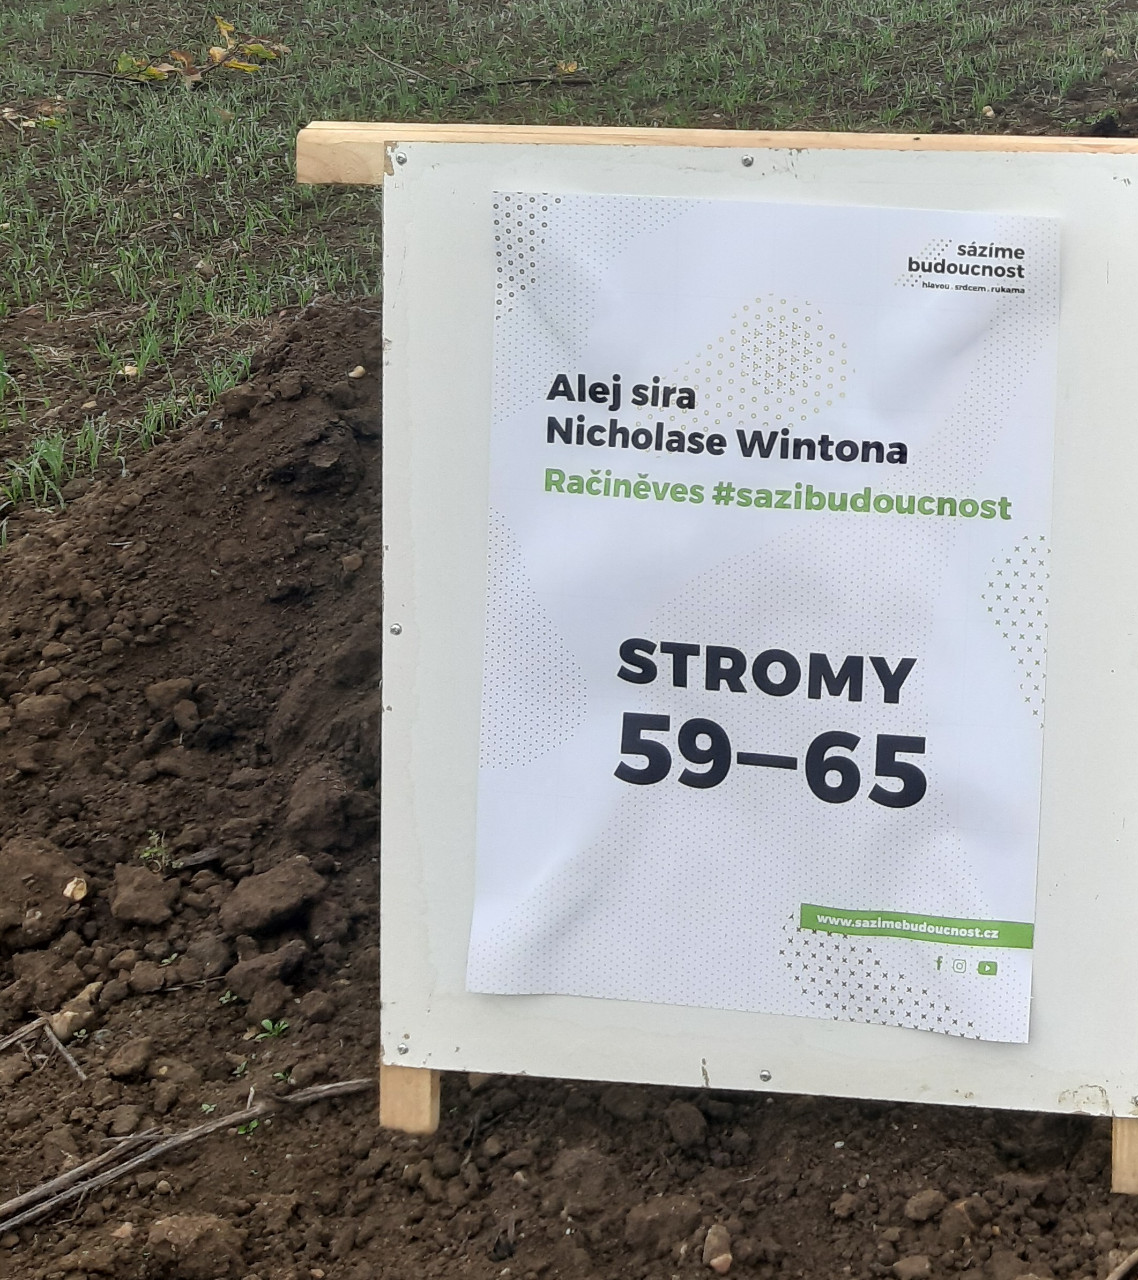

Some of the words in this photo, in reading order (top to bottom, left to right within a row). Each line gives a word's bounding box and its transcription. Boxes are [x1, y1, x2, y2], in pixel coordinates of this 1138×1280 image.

[908, 257, 1025, 278] budoucnost
[957, 241, 1025, 259] sázíme
[546, 374, 621, 411] Alej
[631, 376, 697, 409] sira
[546, 415, 728, 456] Nicholase
[736, 429, 908, 464] Wintona
[544, 468, 705, 504] Račiněves
[712, 481, 1012, 521] #sazibudoucnost
[617, 638, 918, 704] STROMY
[816, 913, 999, 939] www.sazimebudoucnost.cz
